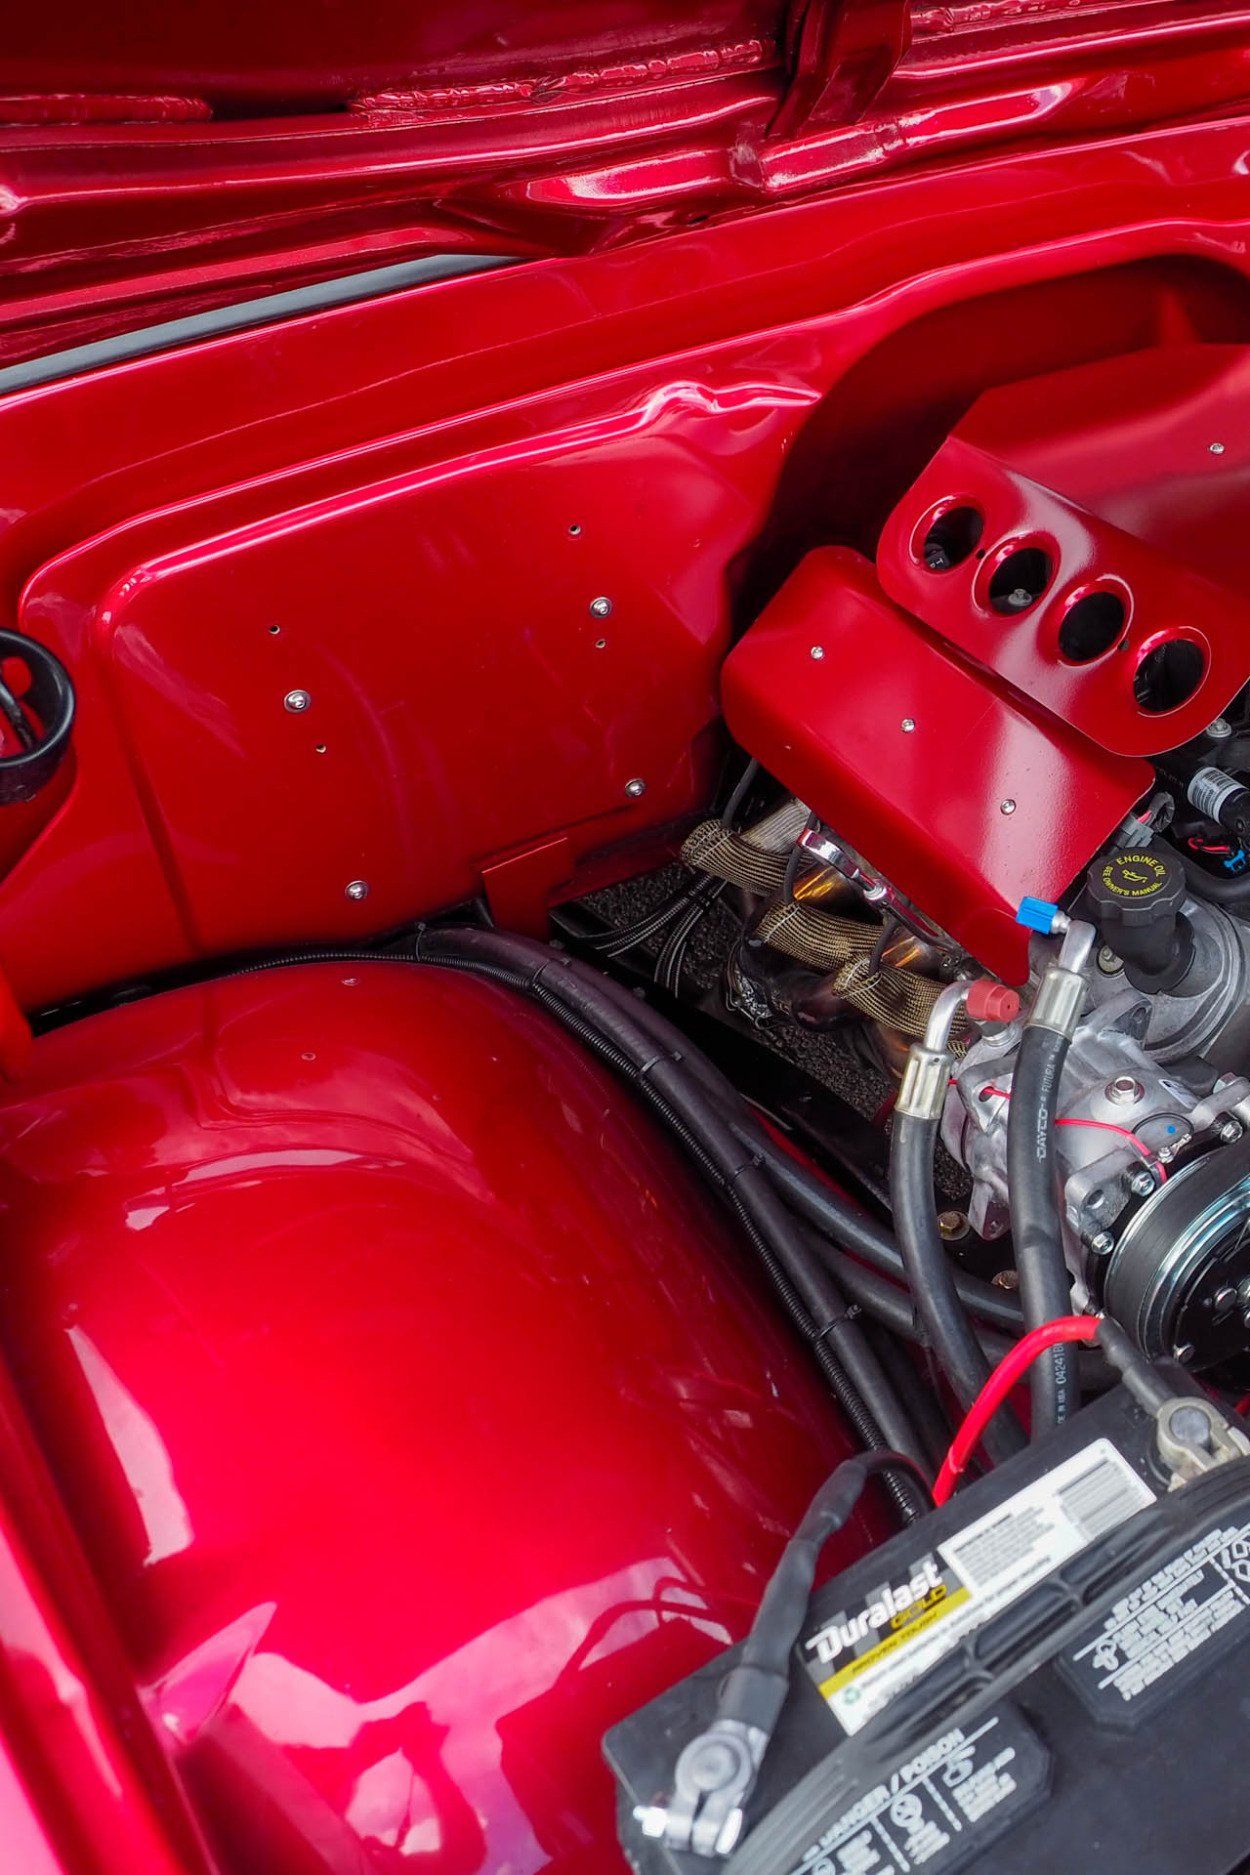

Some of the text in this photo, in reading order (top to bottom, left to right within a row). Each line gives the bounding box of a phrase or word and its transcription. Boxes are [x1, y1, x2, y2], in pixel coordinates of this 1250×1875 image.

[1102, 866, 1163, 896] SEE OWNER'S MANUAL
[1116, 855, 1167, 878] ENGINE OIL
[805, 1560, 943, 1664] Duralast
[890, 1584, 948, 1630] GOLD
